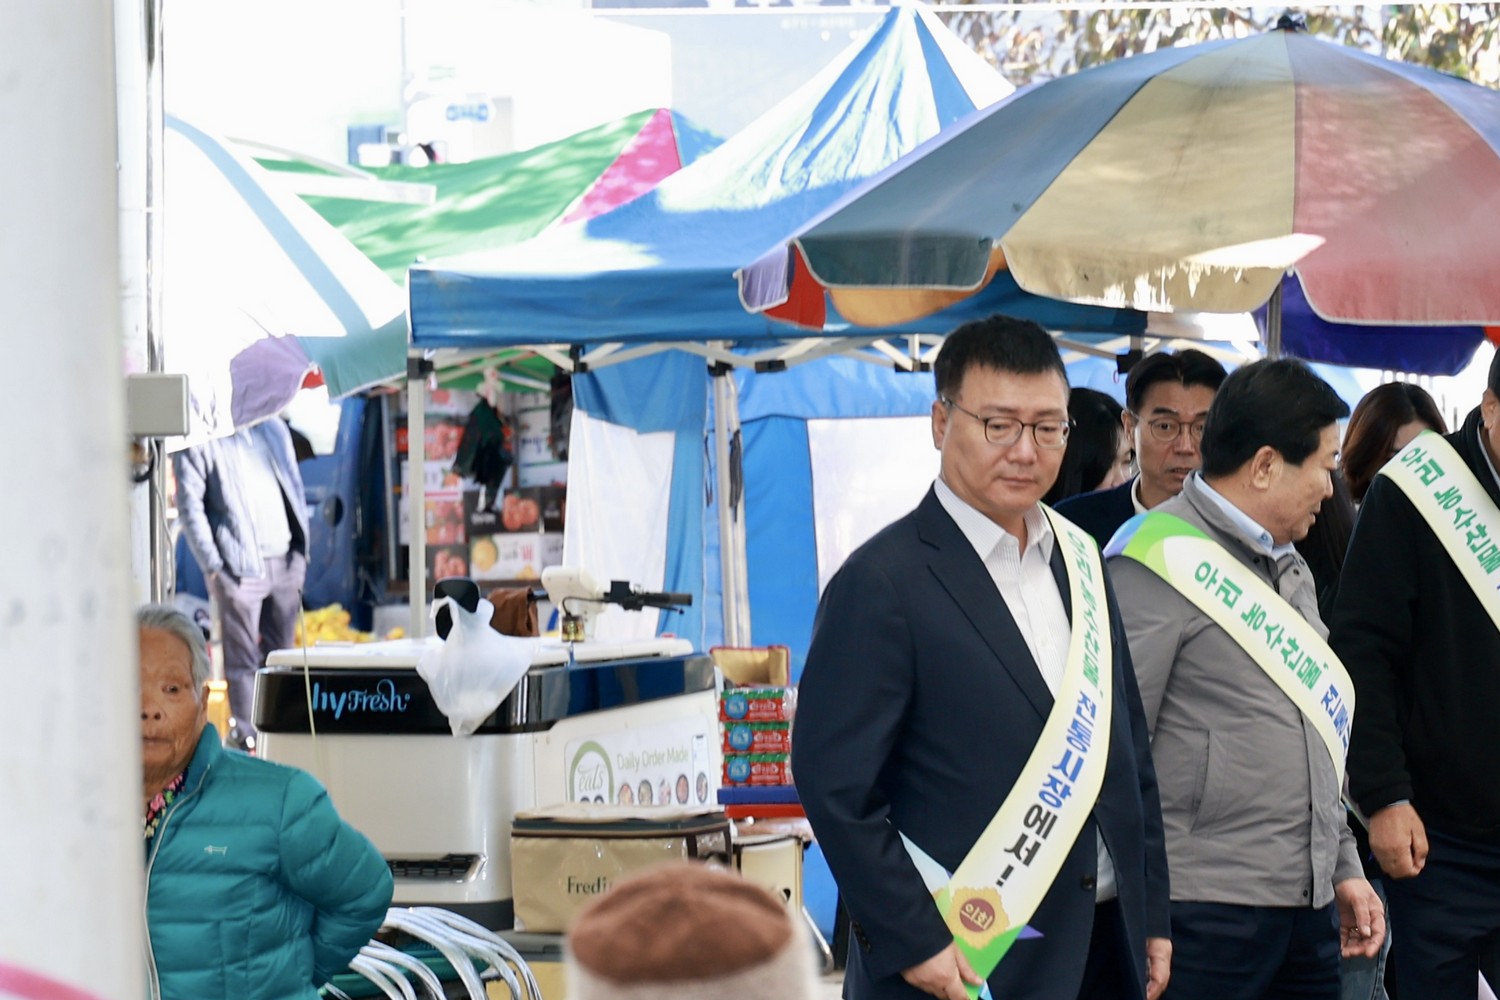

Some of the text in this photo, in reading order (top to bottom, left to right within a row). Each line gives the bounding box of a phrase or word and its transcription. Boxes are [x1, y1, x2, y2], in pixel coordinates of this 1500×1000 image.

[1400, 446, 1446, 487] 우리
[1067, 530, 1093, 583] 우리
[1194, 560, 1243, 609] 우리
[1240, 603, 1329, 690] 농수산물,
[617, 752, 641, 774] Daily
[641, 749, 665, 768] Order
[996, 693, 1096, 887] 전통시장에서!
[567, 875, 613, 895] Fredi
[960, 903, 993, 930] 의회
